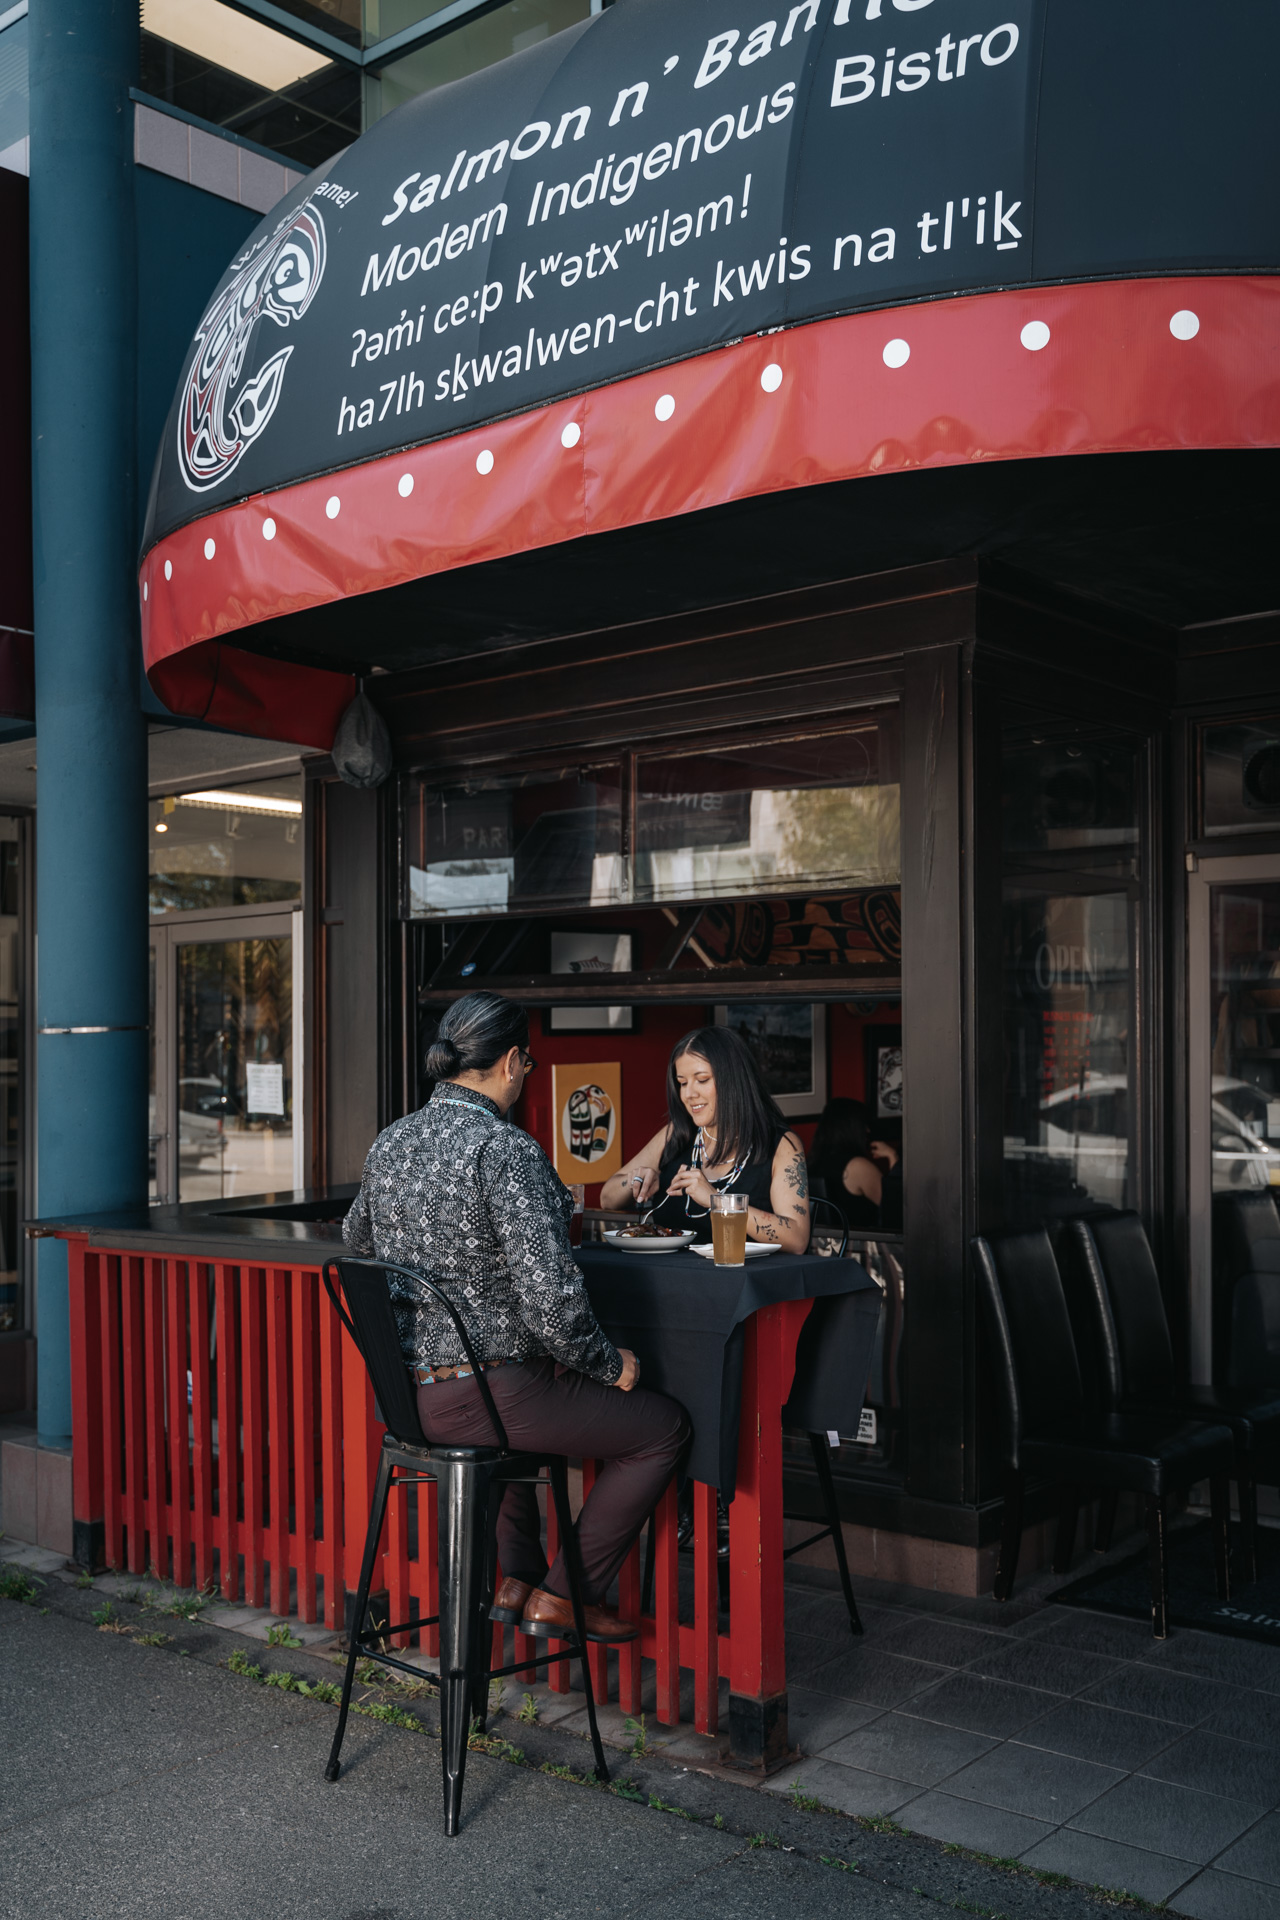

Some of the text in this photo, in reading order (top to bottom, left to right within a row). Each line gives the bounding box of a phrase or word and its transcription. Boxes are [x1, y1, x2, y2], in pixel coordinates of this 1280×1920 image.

[306, 181, 359, 209] ame!
[360, 202, 508, 297] Modern
[526, 81, 796, 227] Indigenous
[830, 22, 1020, 108] Bistro
[381, 105, 592, 227] Salmon
[693, 0, 935, 89] Ban
[337, 370, 425, 436] ha7lh
[712, 237, 811, 308] kwis
[833, 227, 896, 271] na
[1034, 942, 1098, 992] OPEN
